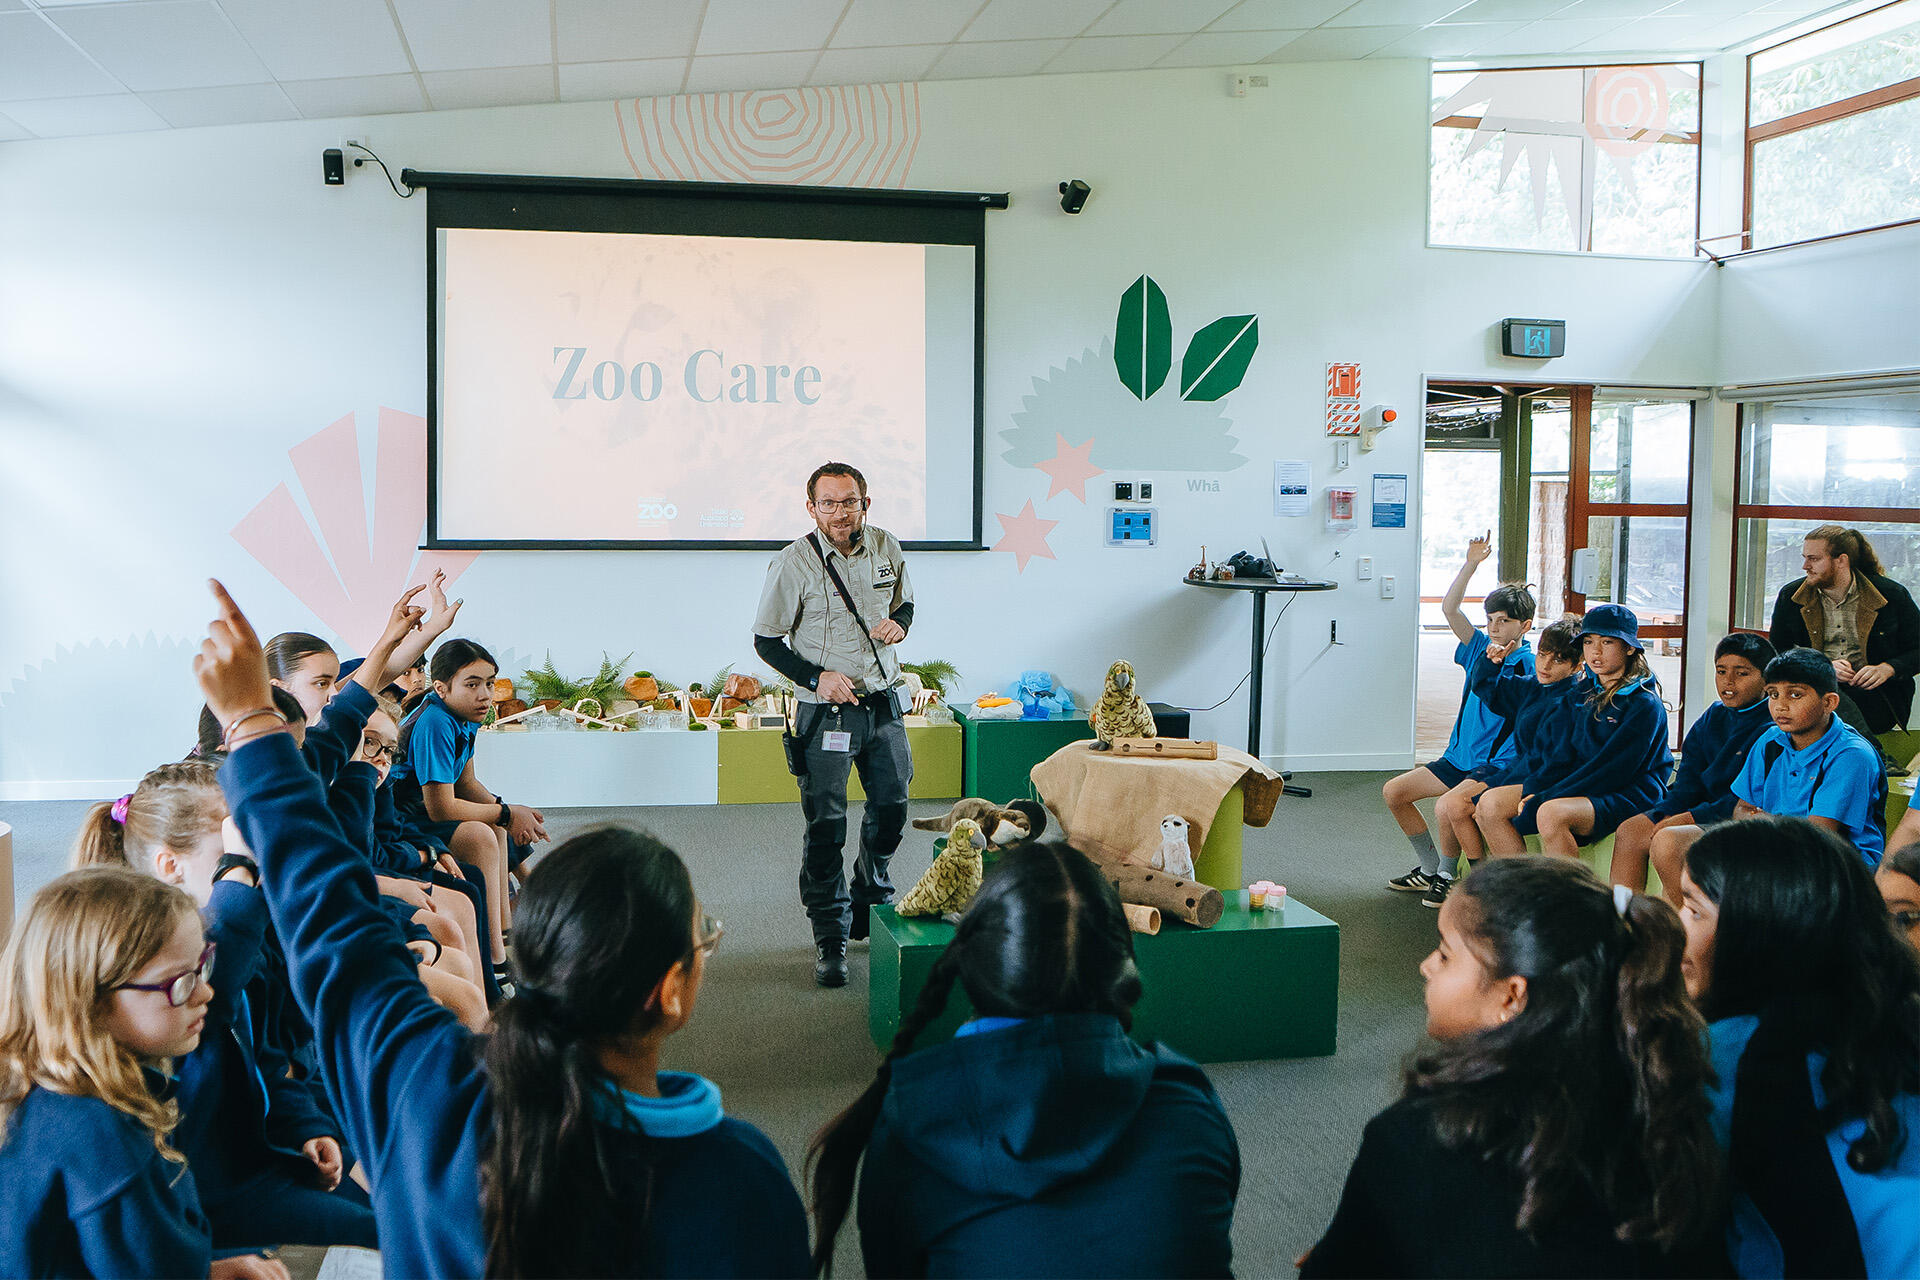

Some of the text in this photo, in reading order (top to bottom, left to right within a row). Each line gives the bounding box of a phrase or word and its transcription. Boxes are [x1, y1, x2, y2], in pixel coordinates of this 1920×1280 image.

[552, 346, 822, 406] Zoo Care
[1187, 480, 1220, 492] Whā
[637, 503, 678, 520] ZOO
